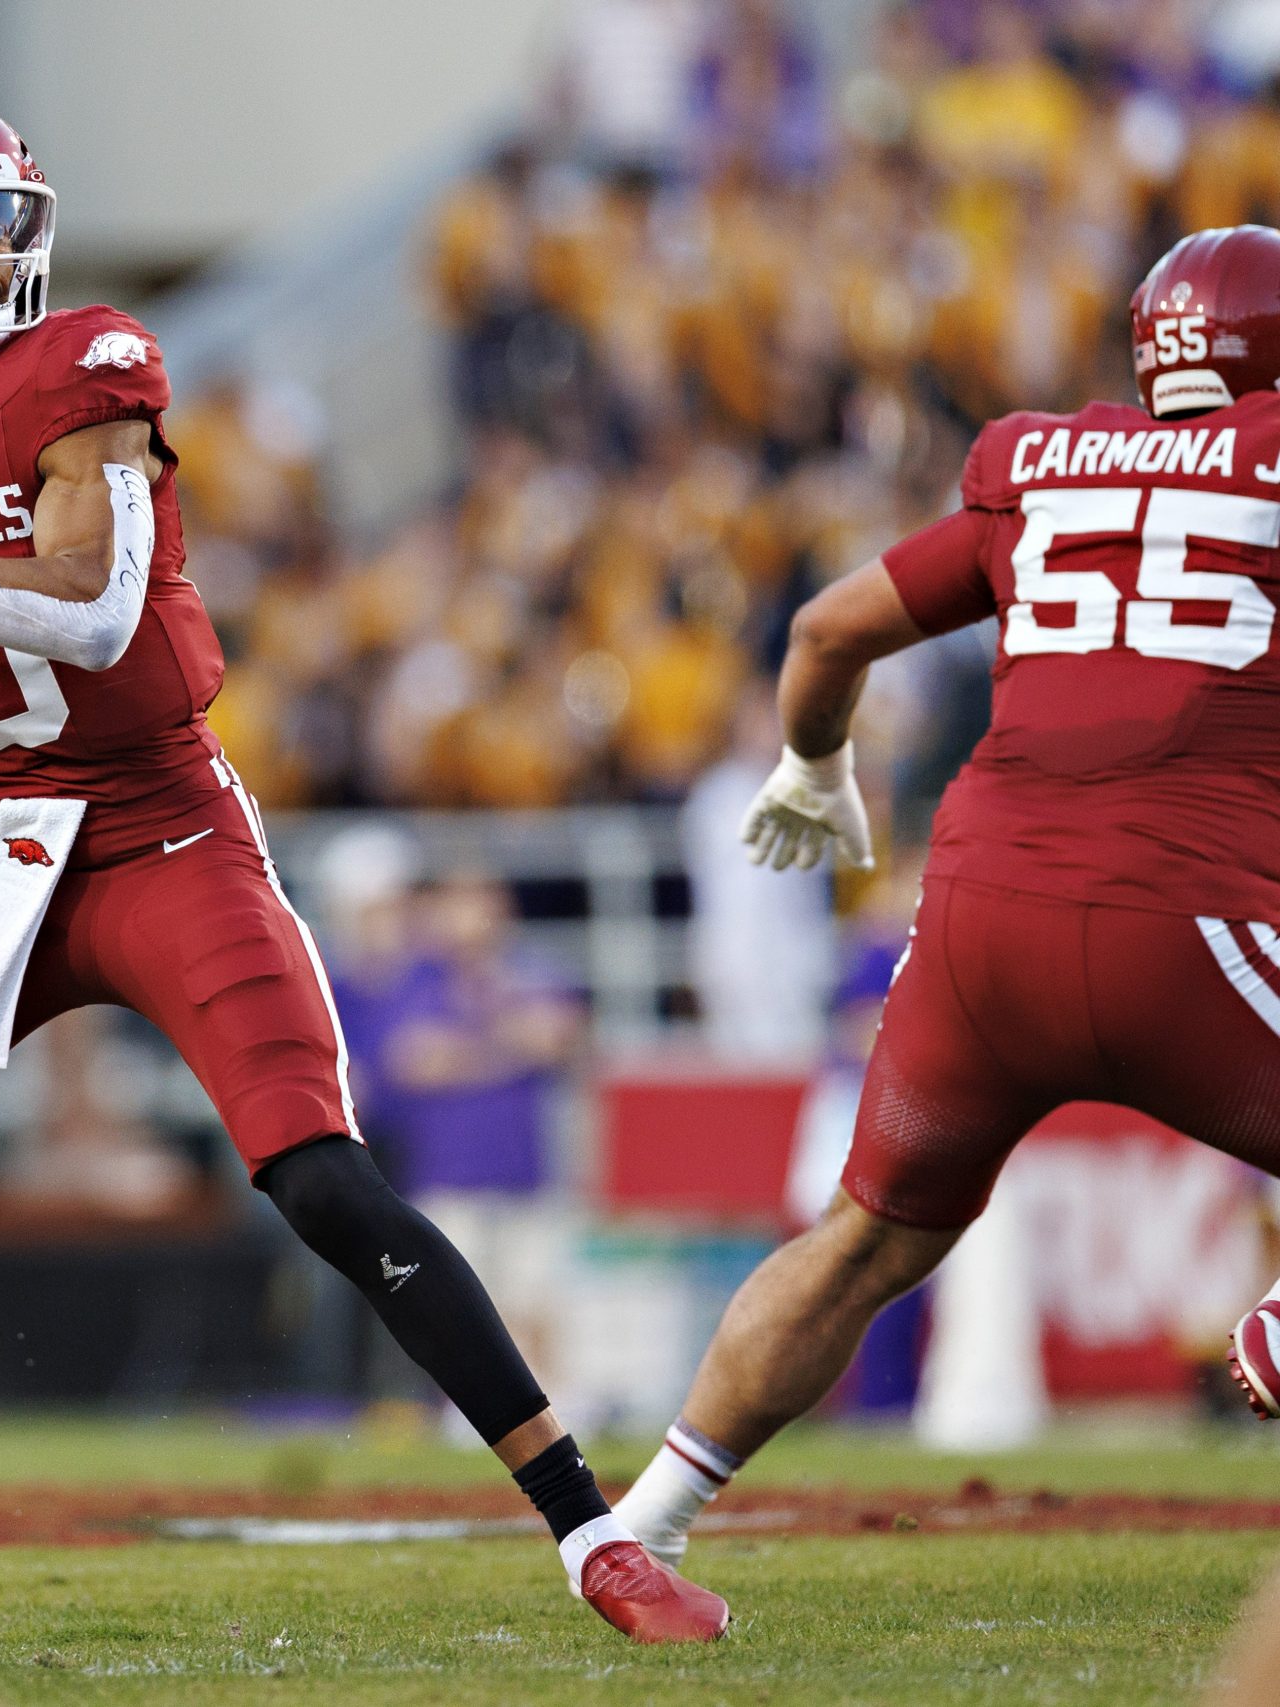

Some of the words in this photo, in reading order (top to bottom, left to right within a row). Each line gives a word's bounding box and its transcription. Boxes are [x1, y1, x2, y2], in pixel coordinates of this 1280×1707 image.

[1155, 315, 1208, 366] 55
[1010, 428, 1237, 484] CARMONA
[1004, 487, 1280, 671] 55
[390, 1262, 421, 1293] MUELLER
